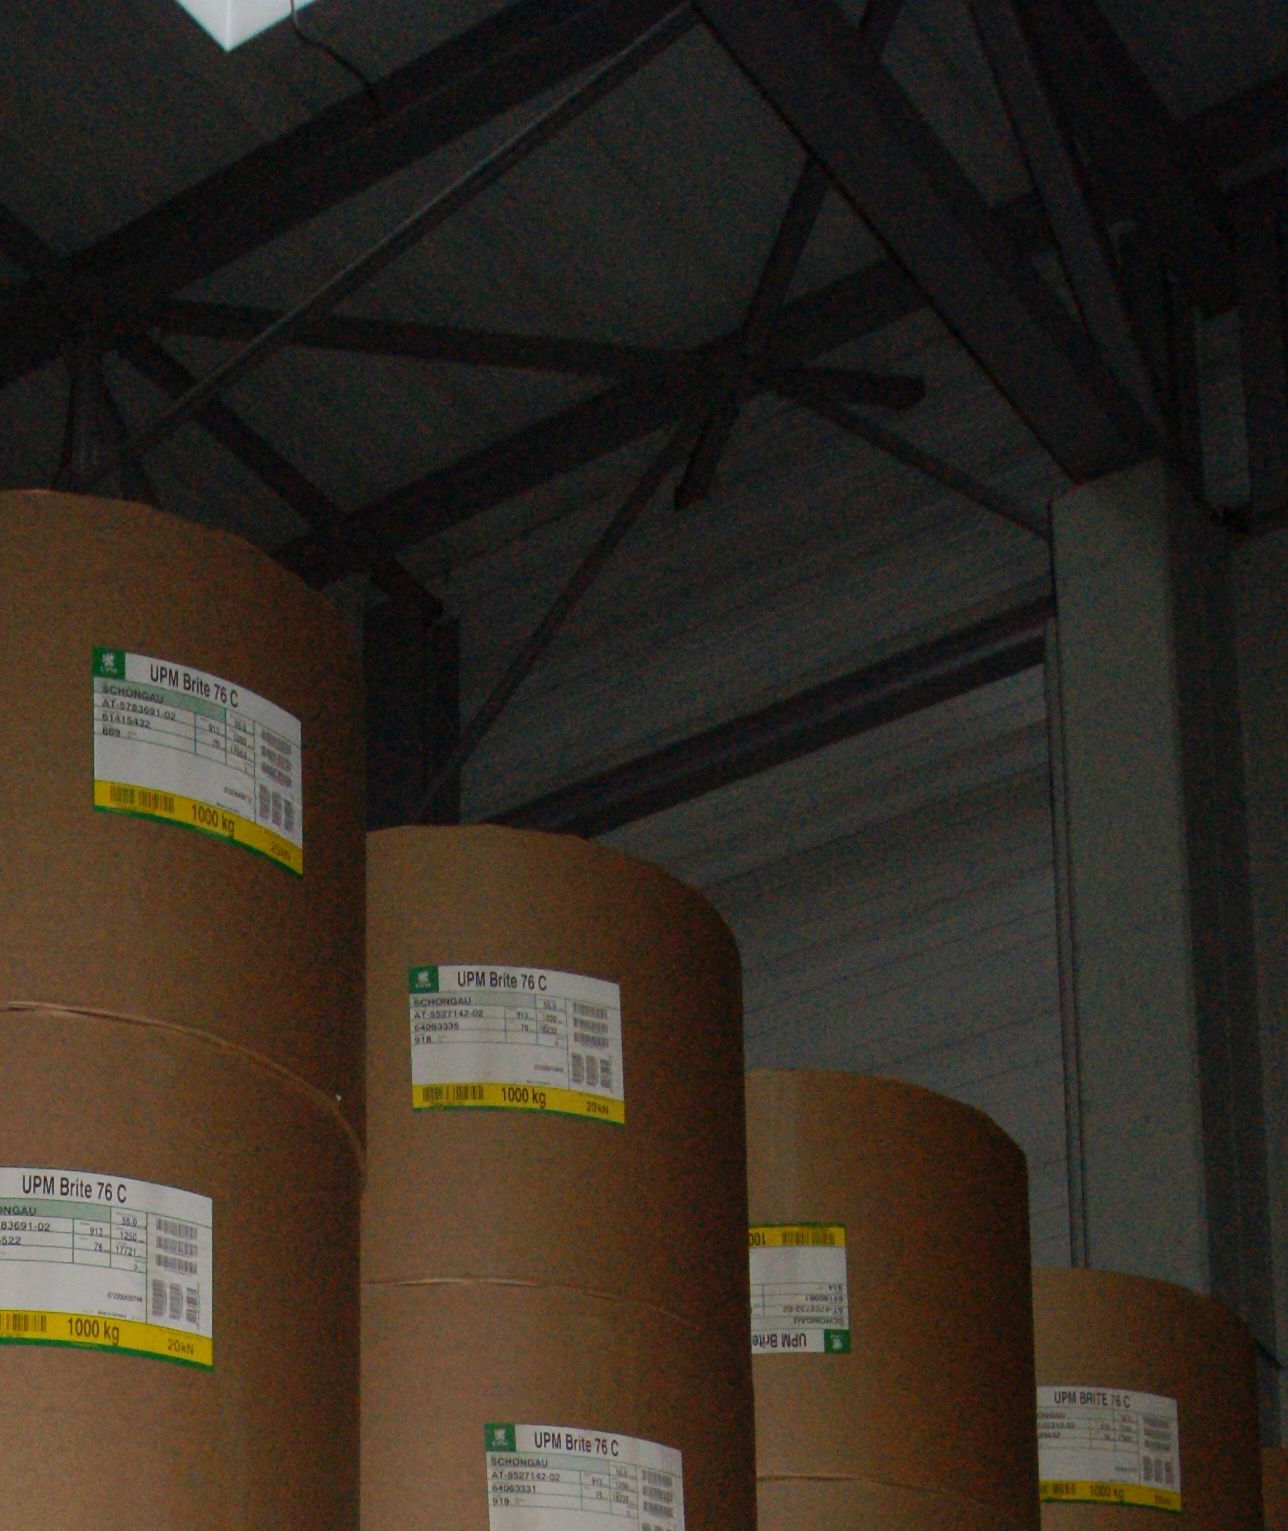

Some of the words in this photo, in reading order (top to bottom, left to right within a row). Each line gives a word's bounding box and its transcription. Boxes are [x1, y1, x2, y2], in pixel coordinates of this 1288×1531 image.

[151, 665, 178, 687] UPM
[184, 674, 210, 698] Brite
[214, 683, 227, 702] 76
[231, 690, 238, 707] C
[457, 971, 486, 987] UPM
[490, 972, 517, 988] Brite
[521, 974, 535, 990] 76
[538, 975, 547, 991] C
[22, 1175, 55, 1194] UPM
[60, 1179, 92, 1198] Brite
[97, 1182, 112, 1200] 76
[117, 1184, 126, 1203] C
[753, 1334, 777, 1348] Brite
[782, 1333, 806, 1348] UPM
[534, 1431, 562, 1449] UPM
[566, 1435, 592, 1453] Brite
[595, 1438, 607, 1454] 76
[610, 1439, 619, 1456] C
